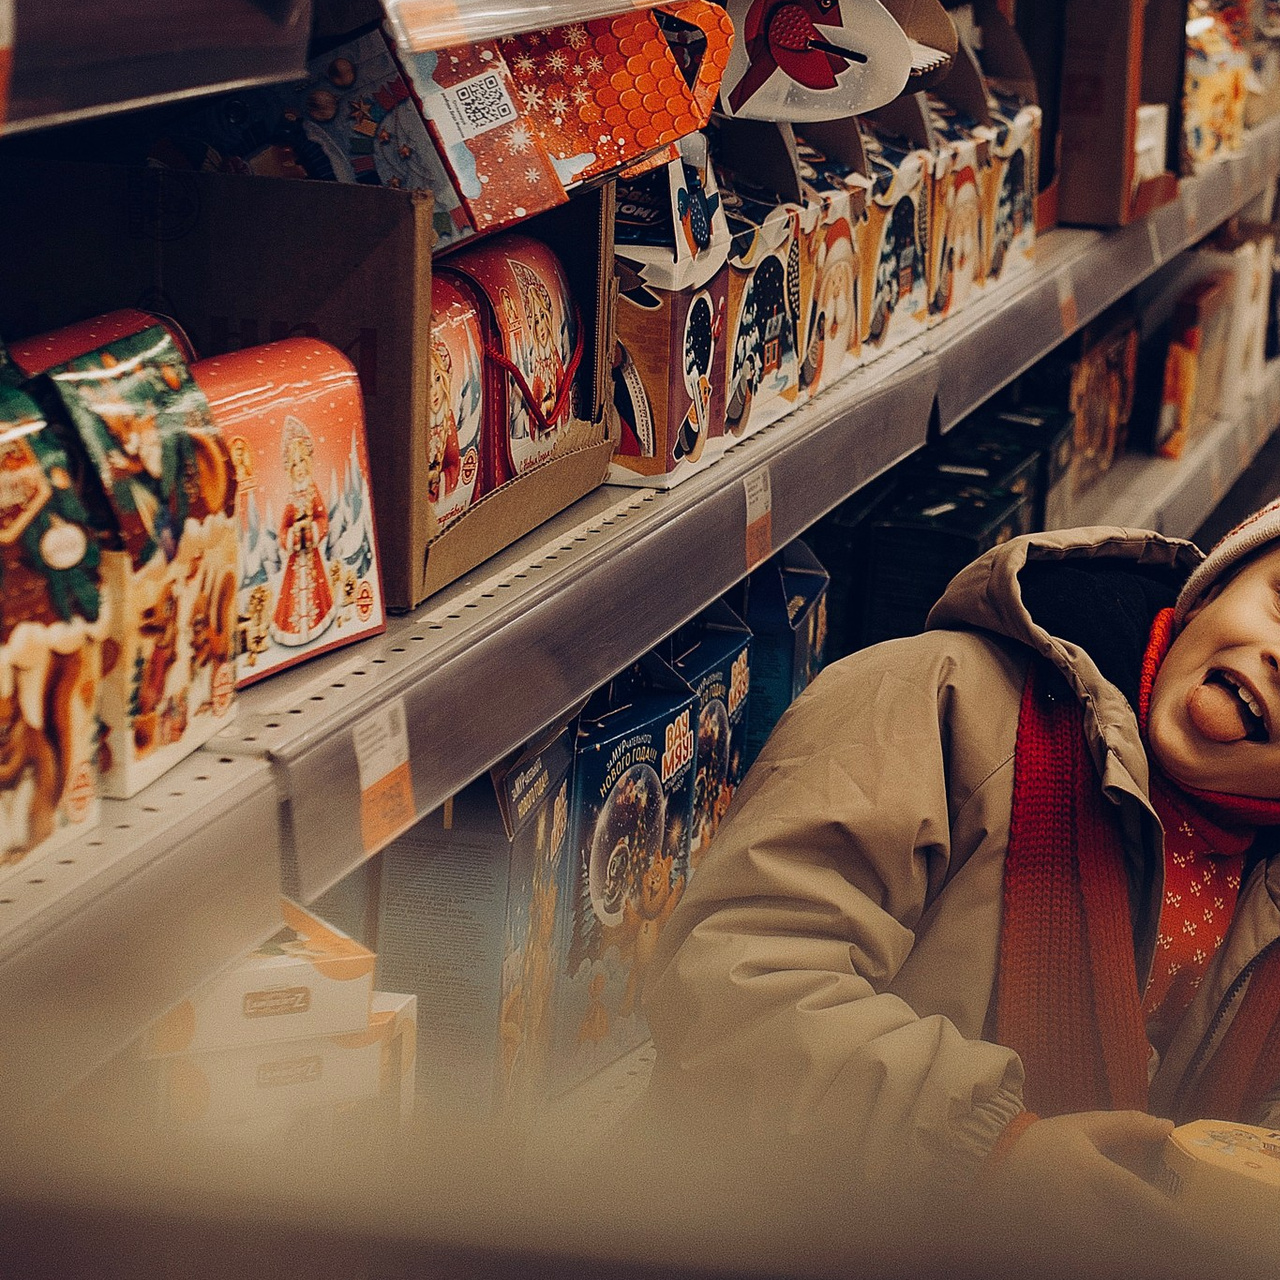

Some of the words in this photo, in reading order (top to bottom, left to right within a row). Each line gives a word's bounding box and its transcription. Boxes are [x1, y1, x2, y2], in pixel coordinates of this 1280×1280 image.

[664, 708, 690, 754] ВАУ
[599, 752, 631, 798] НОВОГО
[662, 730, 694, 783] МЯУ!
